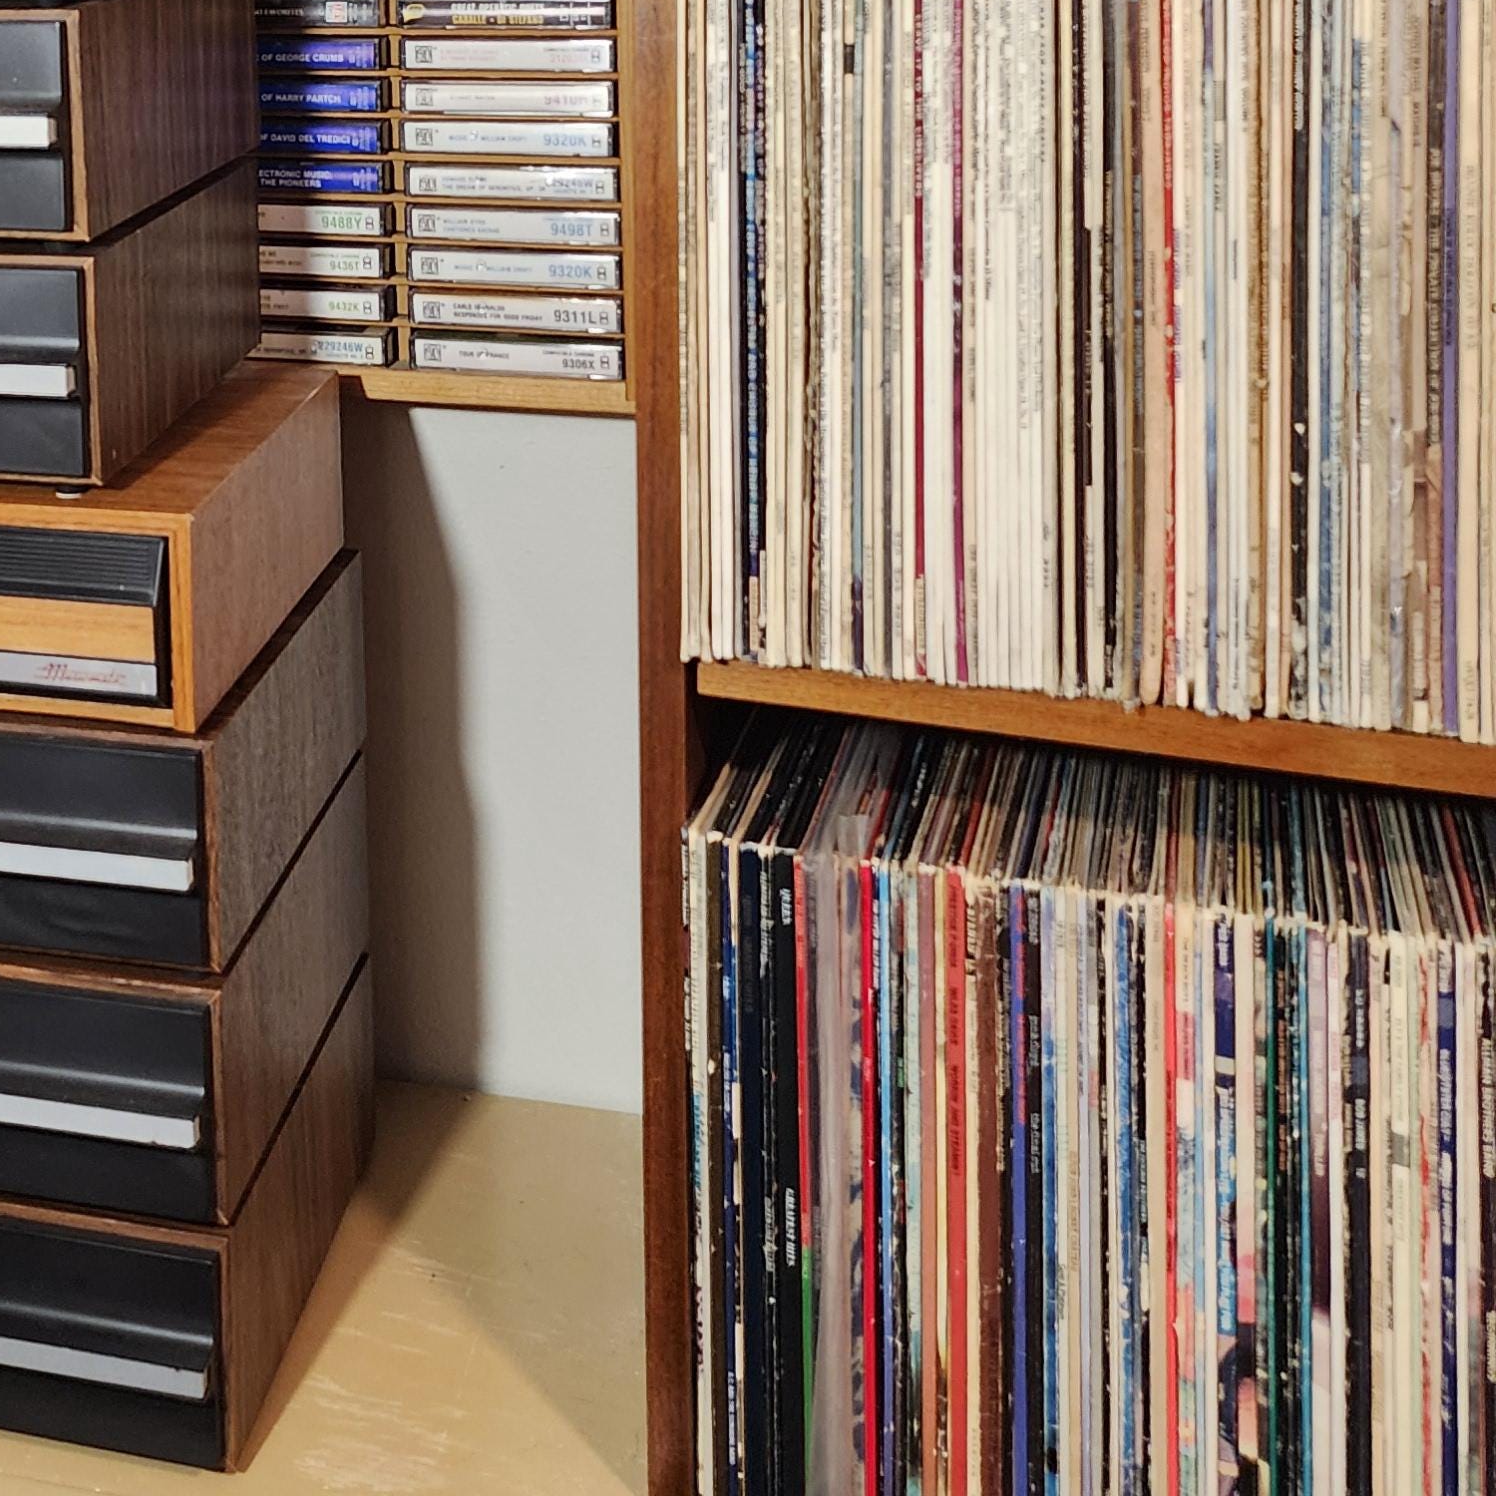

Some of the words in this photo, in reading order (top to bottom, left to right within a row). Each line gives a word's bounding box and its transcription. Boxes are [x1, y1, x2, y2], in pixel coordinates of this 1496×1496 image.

[261, 53, 273, 63] OF
[276, 53, 310, 63] GEORGE
[312, 53, 345, 63] CRUMB
[261, 93, 274, 102] OF
[275, 93, 304, 103] HARRY
[306, 93, 341, 104] PARTCH
[271, 133, 296, 143] DAVID
[298, 134, 315, 144] DEL
[316, 134, 351, 145] TREDICI
[260, 178, 276, 187] THE
[278, 178, 322, 189] PIONEERS
[321, 215, 361, 229] 9488Y
[550, 223, 593, 237] 9498T
[548, 263, 593, 279] 9320K
[553, 309, 597, 324] 9311L
[562, 359, 595, 370] 9306X
[1482, 1038, 1494, 1084] ALLMAN
[1483, 1086, 1495, 1144] BROTHERS
